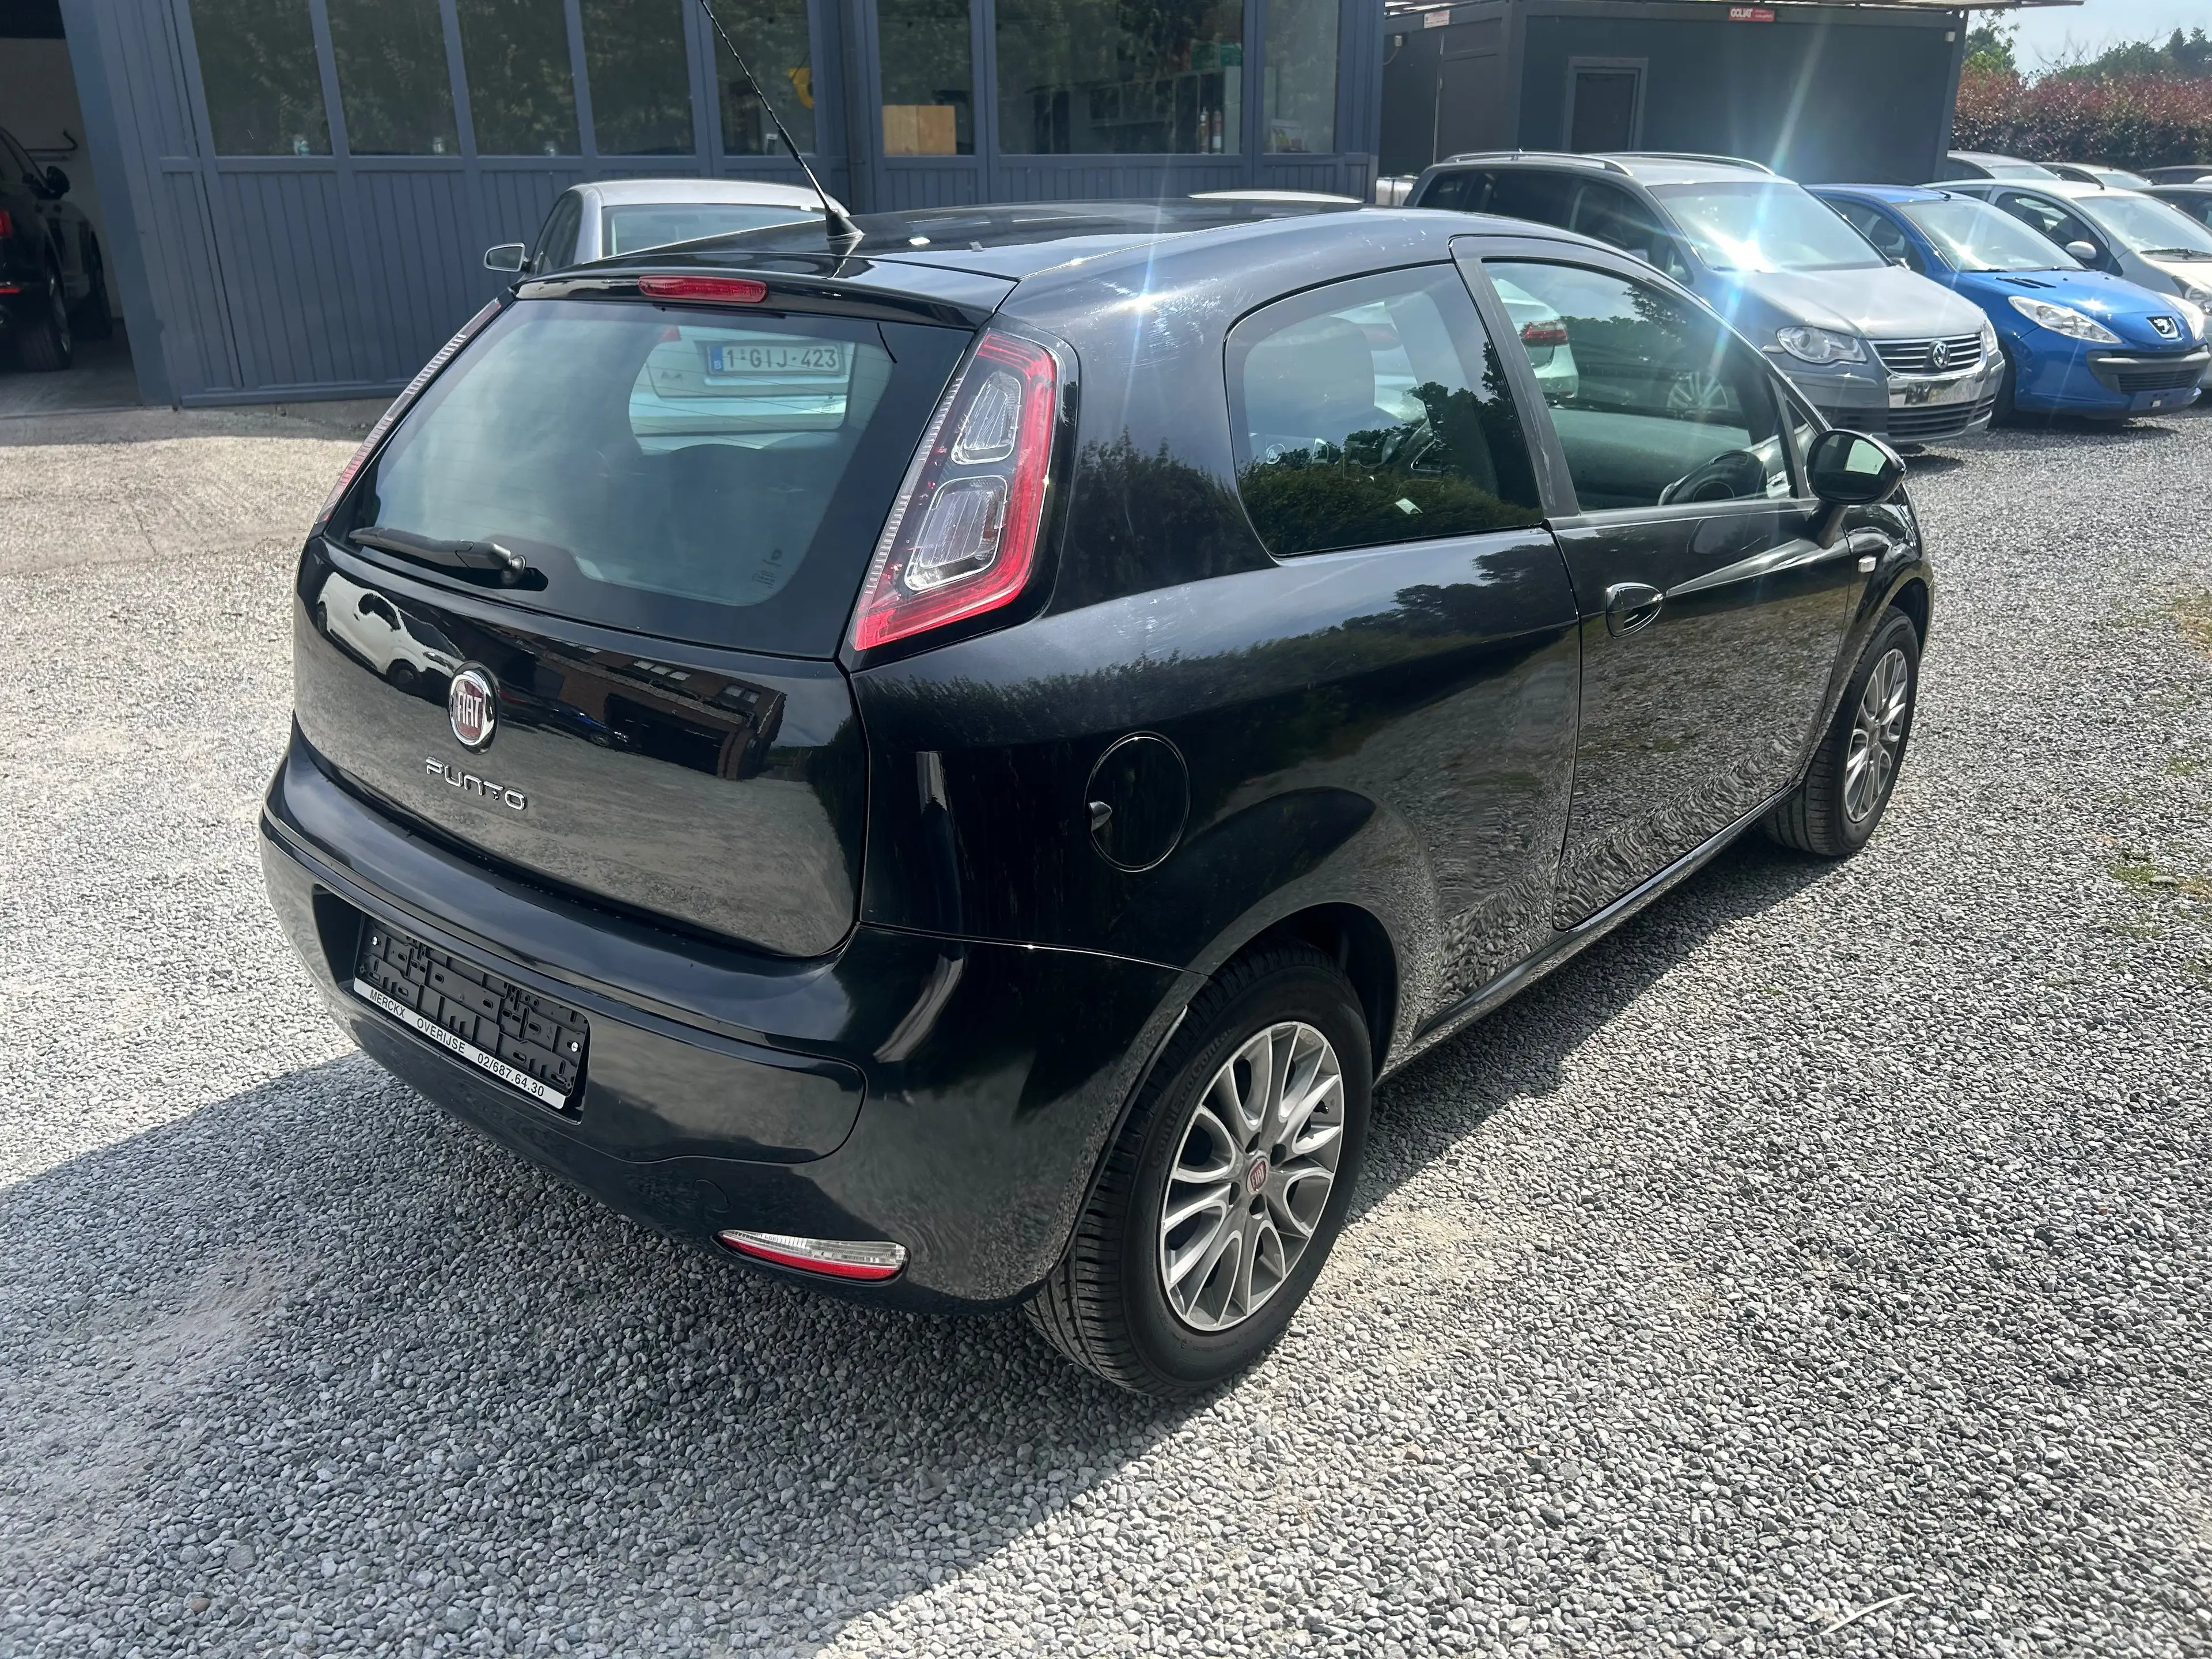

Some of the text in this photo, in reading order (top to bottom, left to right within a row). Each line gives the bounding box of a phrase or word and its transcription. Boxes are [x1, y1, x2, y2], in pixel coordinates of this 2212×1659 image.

[457, 691, 482, 729] FIAT
[426, 756, 527, 810] PUNTO
[370, 990, 544, 1098] MERCKX OVERIJSE 02/687.64.30
